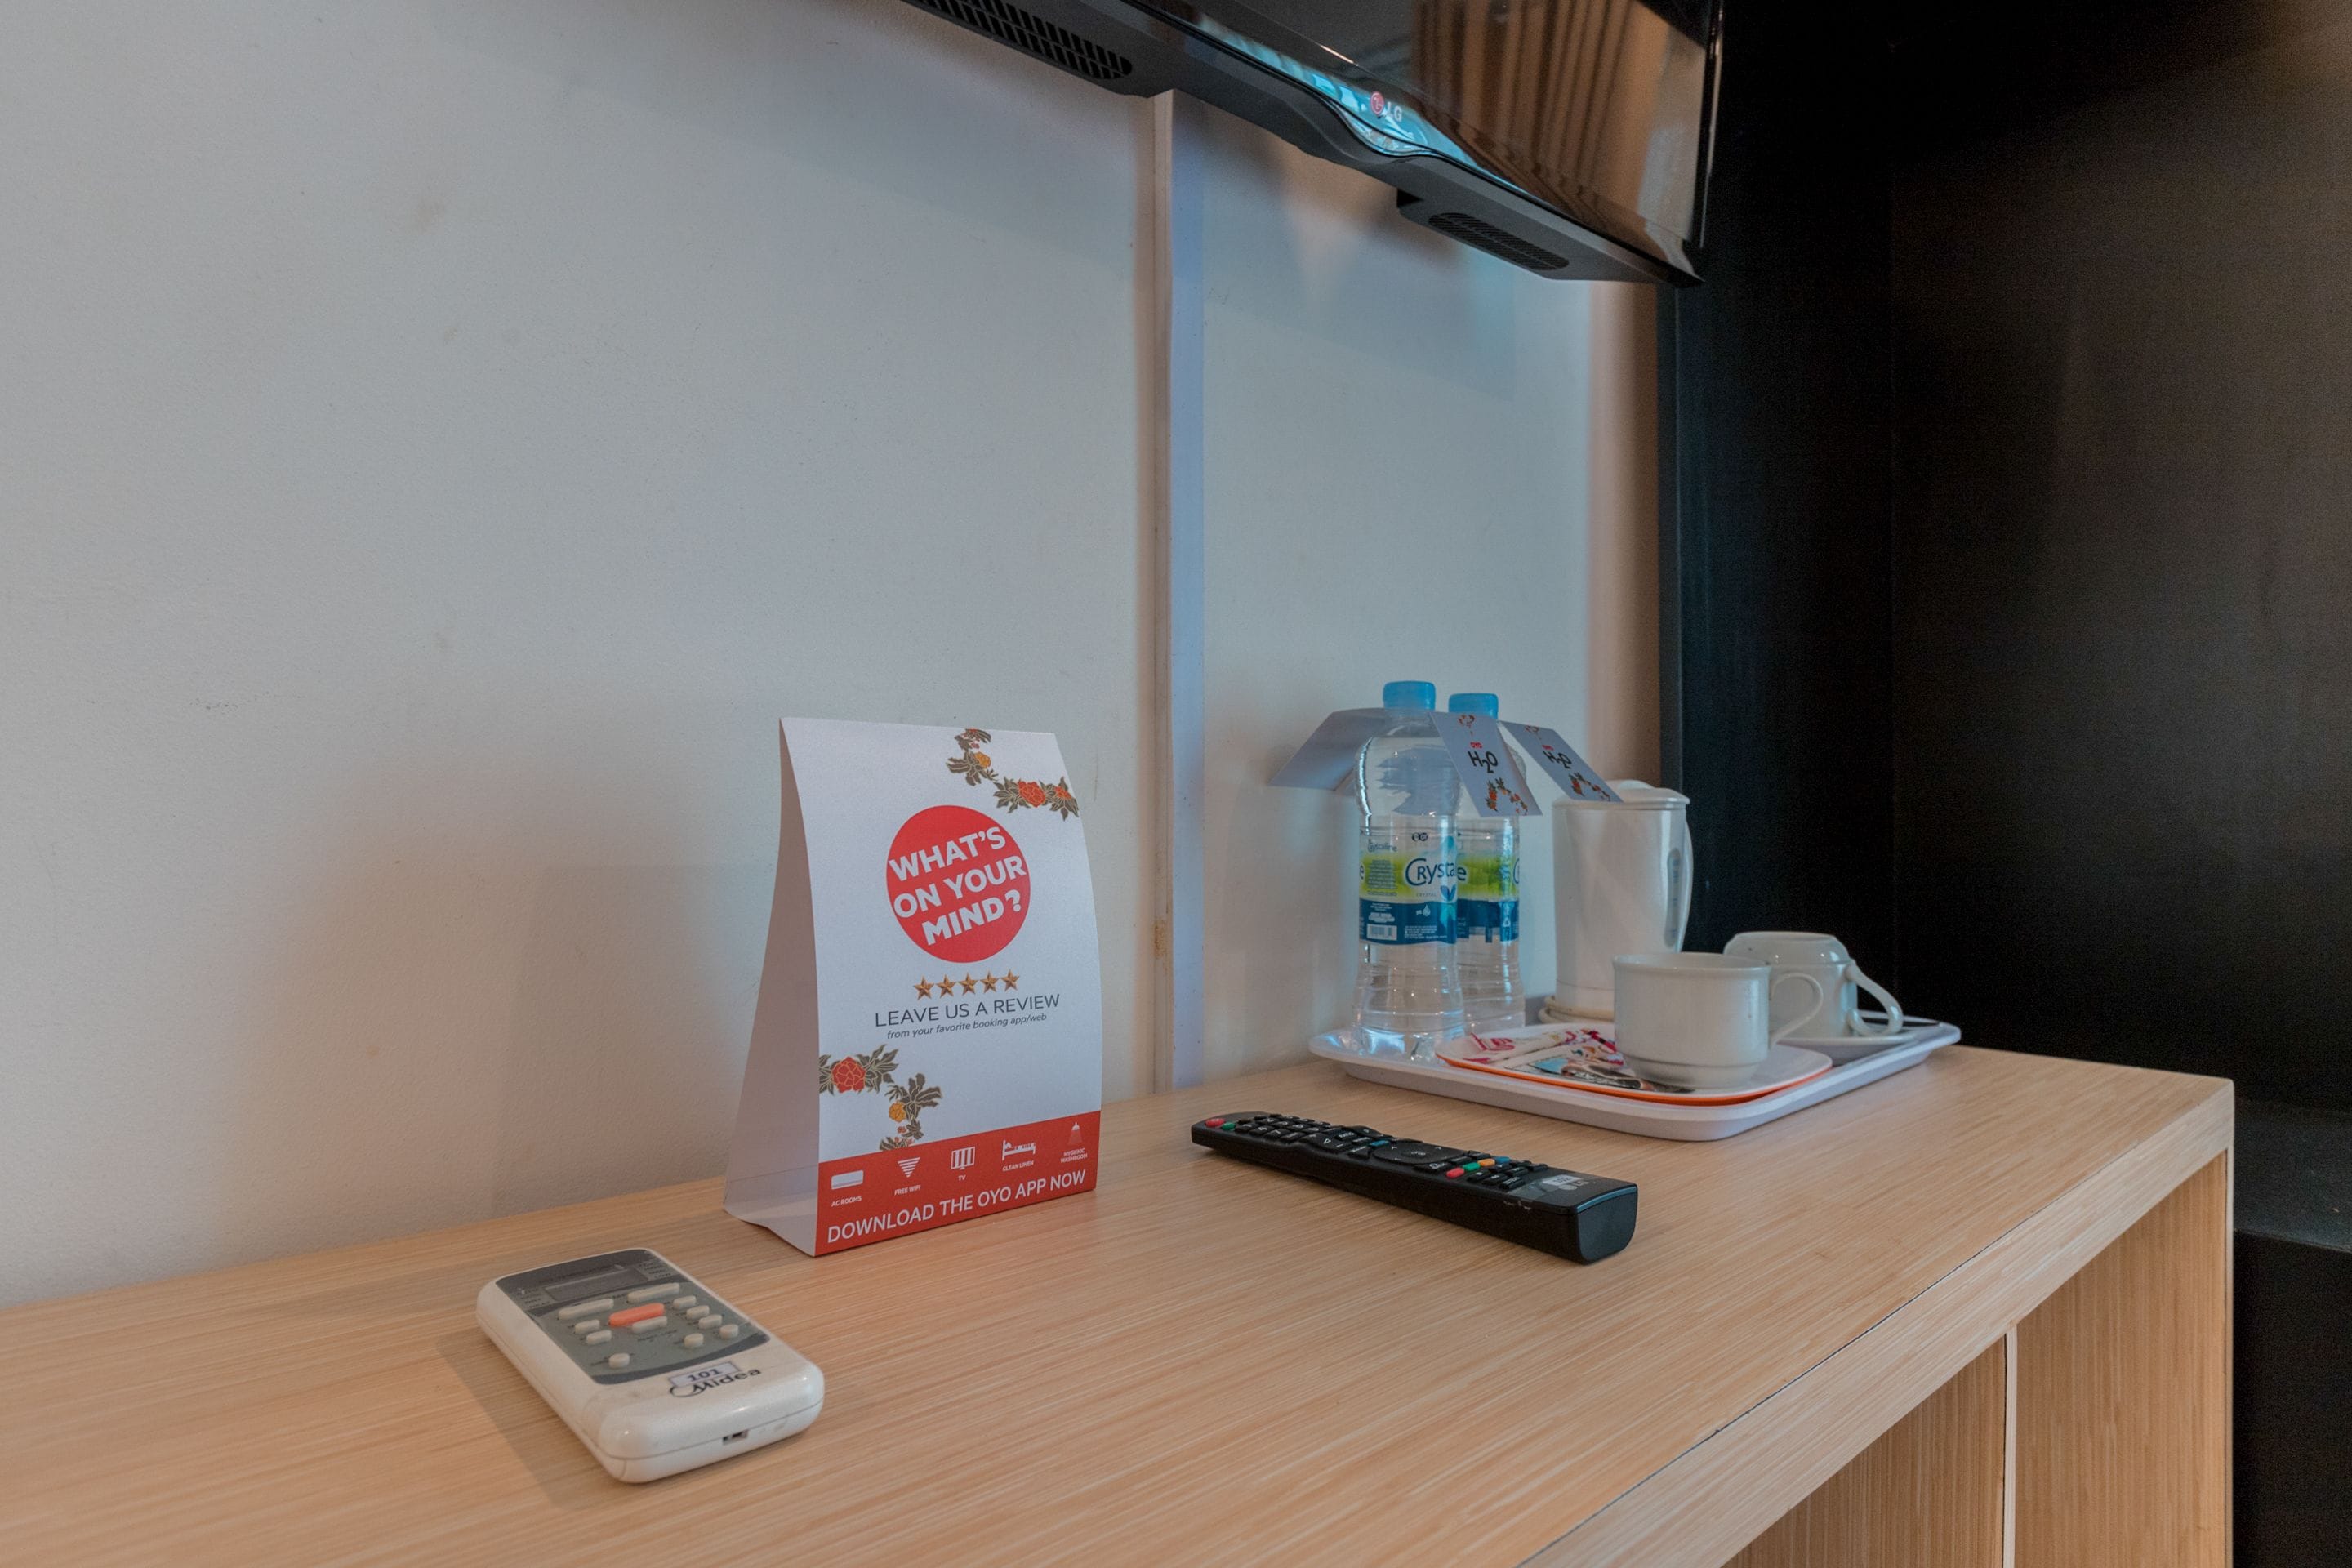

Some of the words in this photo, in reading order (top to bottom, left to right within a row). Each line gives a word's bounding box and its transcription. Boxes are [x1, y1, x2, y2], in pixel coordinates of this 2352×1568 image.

[1388, 100, 1403, 122] LG
[888, 826, 1006, 882] WHAT'S
[893, 883, 942, 918] ON
[943, 855, 1027, 899] YOUR
[921, 889, 1022, 946] MIND?
[875, 1006, 939, 1027] LEAVE
[945, 1003, 969, 1019] US
[975, 1001, 988, 1016] A
[993, 994, 1060, 1013] REVIEW
[887, 1030, 910, 1040] from
[912, 1027, 934, 1038] your
[936, 1022, 971, 1034] favorite
[973, 1017, 1009, 1029] booking
[1010, 1013, 1047, 1025] app/web
[1002, 1163, 1019, 1171] CLEAN
[1019, 1160, 1034, 1169] LINEN
[831, 1199, 840, 1207] AC
[840, 1195, 862, 1206] ROOMS
[894, 1187, 908, 1196] FREE
[909, 1184, 921, 1193] WIFI
[827, 1204, 934, 1243] DOWNLOAD
[939, 1194, 973, 1216] THE
[978, 1186, 1011, 1207] OYO
[1015, 1178, 1046, 1199] APP
[1050, 1169, 1086, 1191] NOW
[669, 1369, 762, 1398] Midea
[688, 1368, 721, 1382] 101
